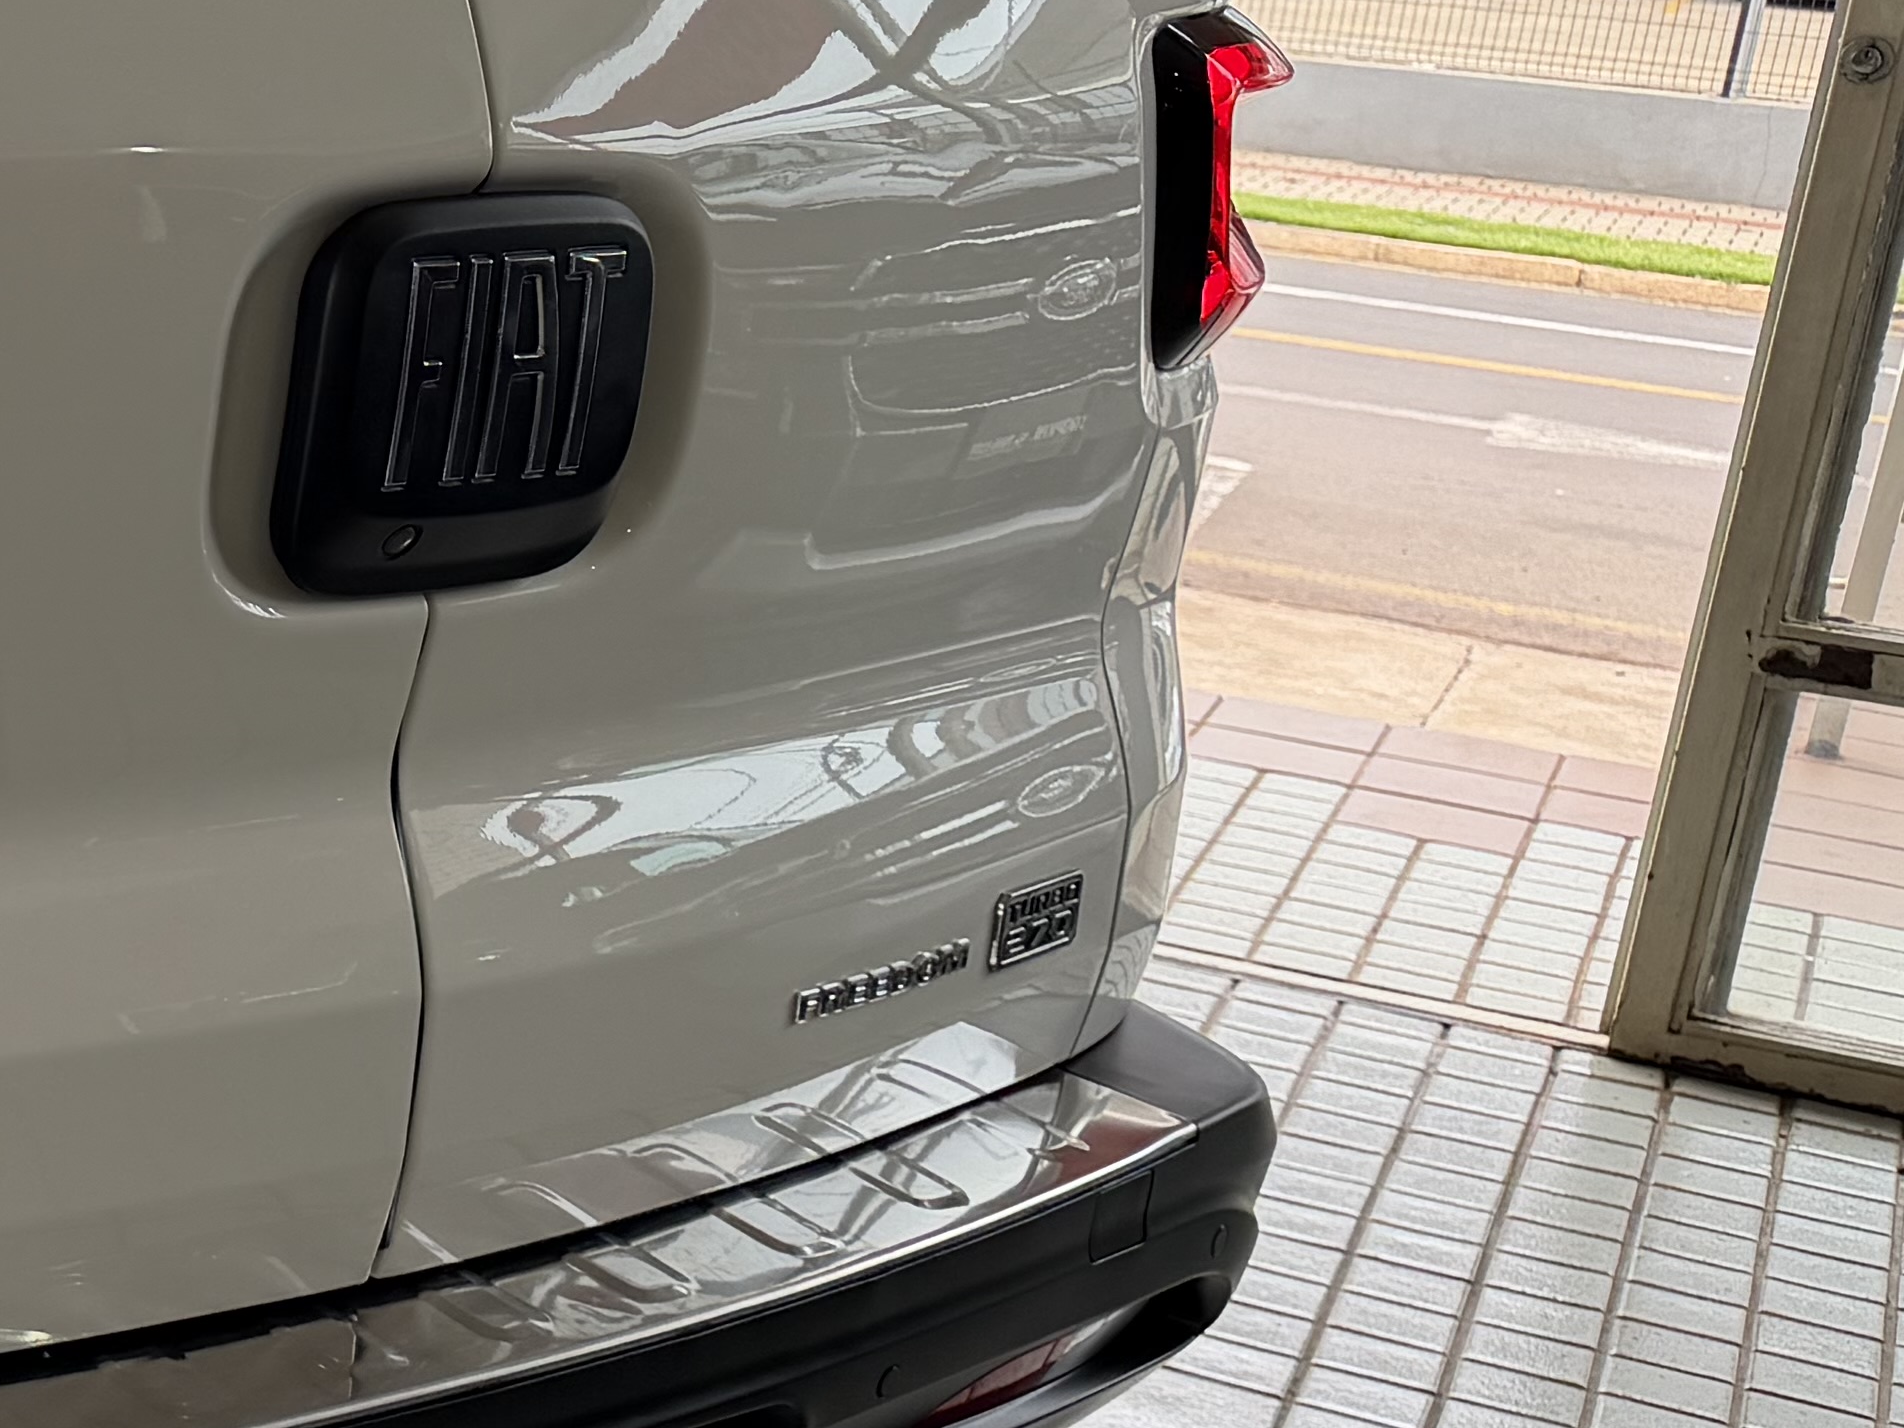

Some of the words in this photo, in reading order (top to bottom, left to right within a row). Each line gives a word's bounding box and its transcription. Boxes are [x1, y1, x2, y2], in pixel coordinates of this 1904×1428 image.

[380, 246, 629, 492] FIAT
[1006, 906, 1074, 954] 270
[1008, 878, 1081, 924] TURBO
[792, 938, 971, 1024] FREEDOM
